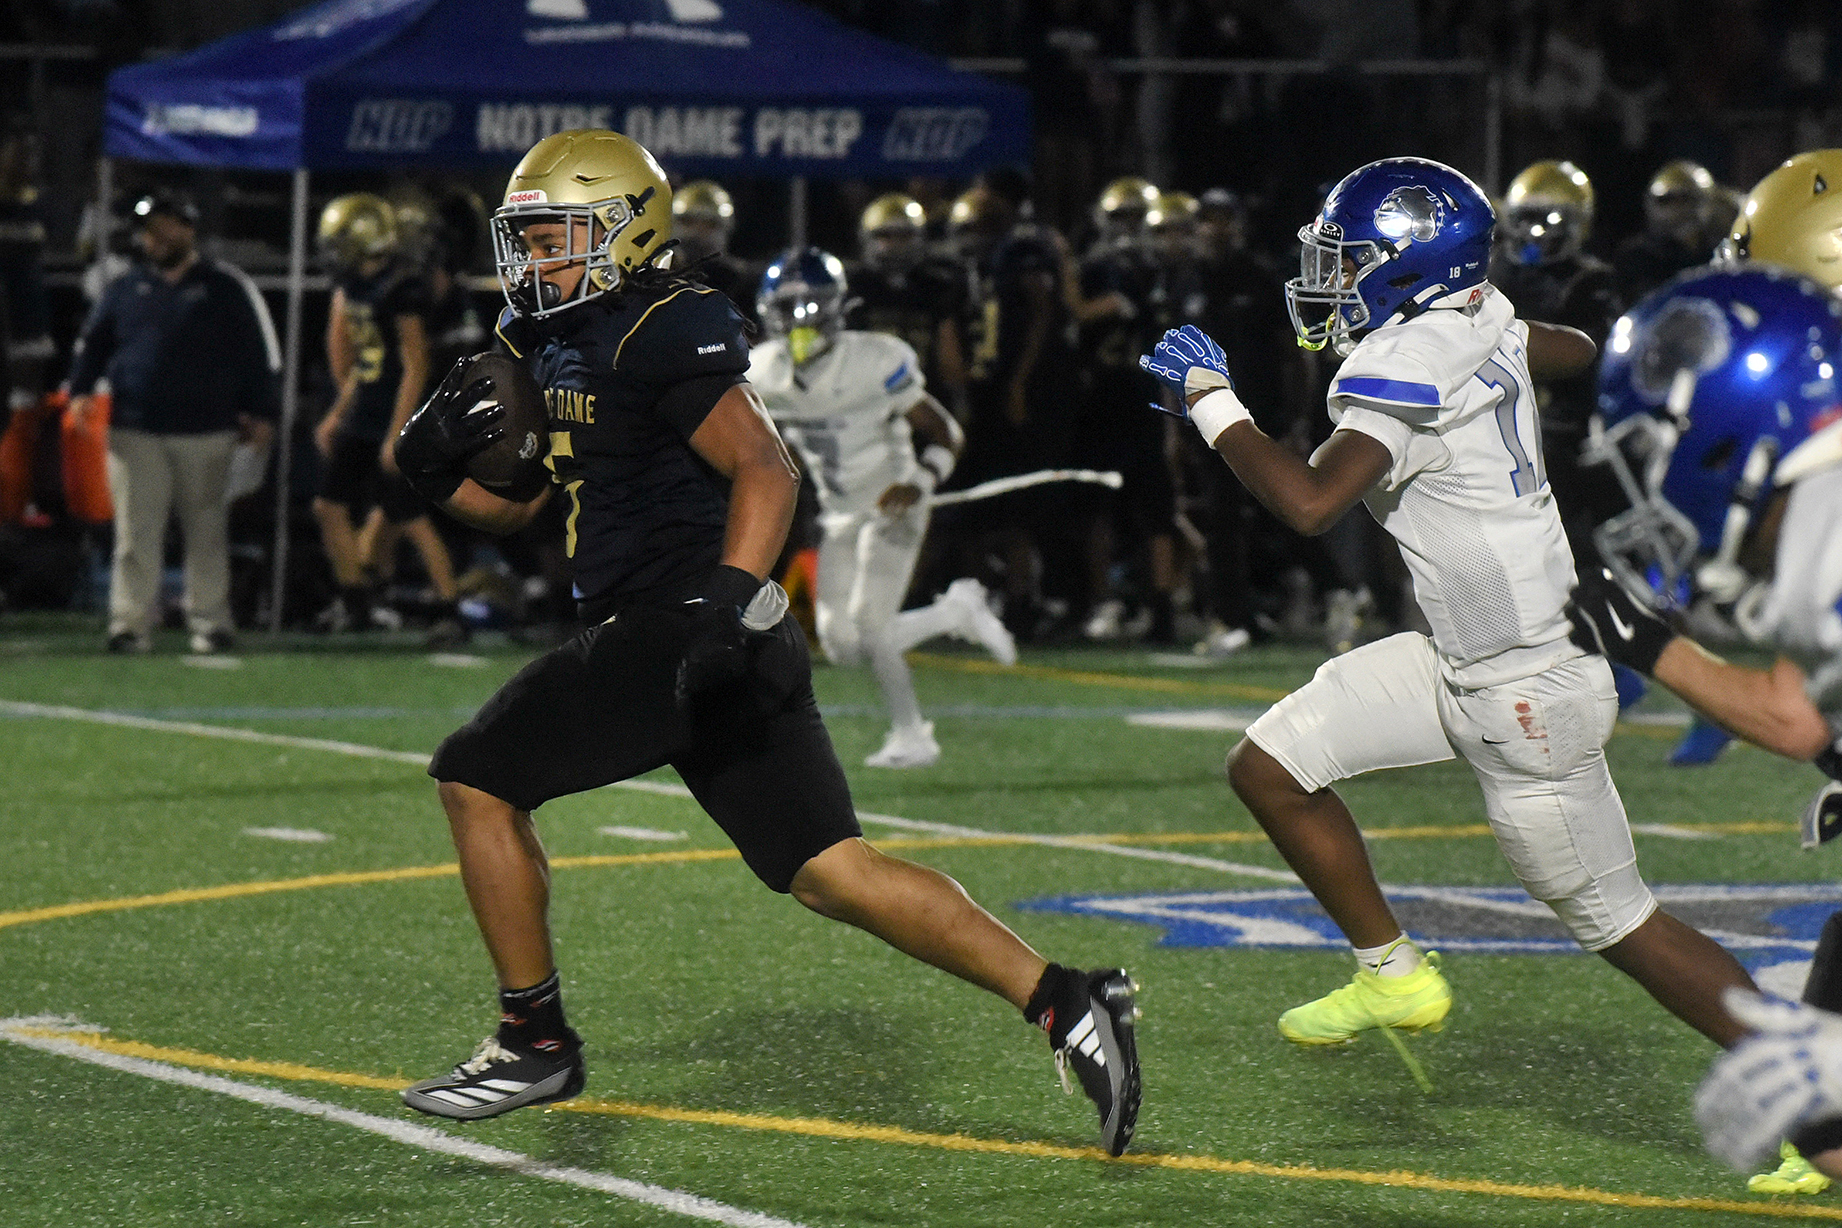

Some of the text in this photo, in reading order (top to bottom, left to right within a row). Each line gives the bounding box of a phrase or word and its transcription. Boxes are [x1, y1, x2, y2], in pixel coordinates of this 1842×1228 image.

[625, 106, 742, 156] DAME
[754, 108, 861, 157] PREP
[1449, 266, 1461, 279] 18
[697, 343, 726, 355] Riddell
[557, 388, 596, 424] DAME
